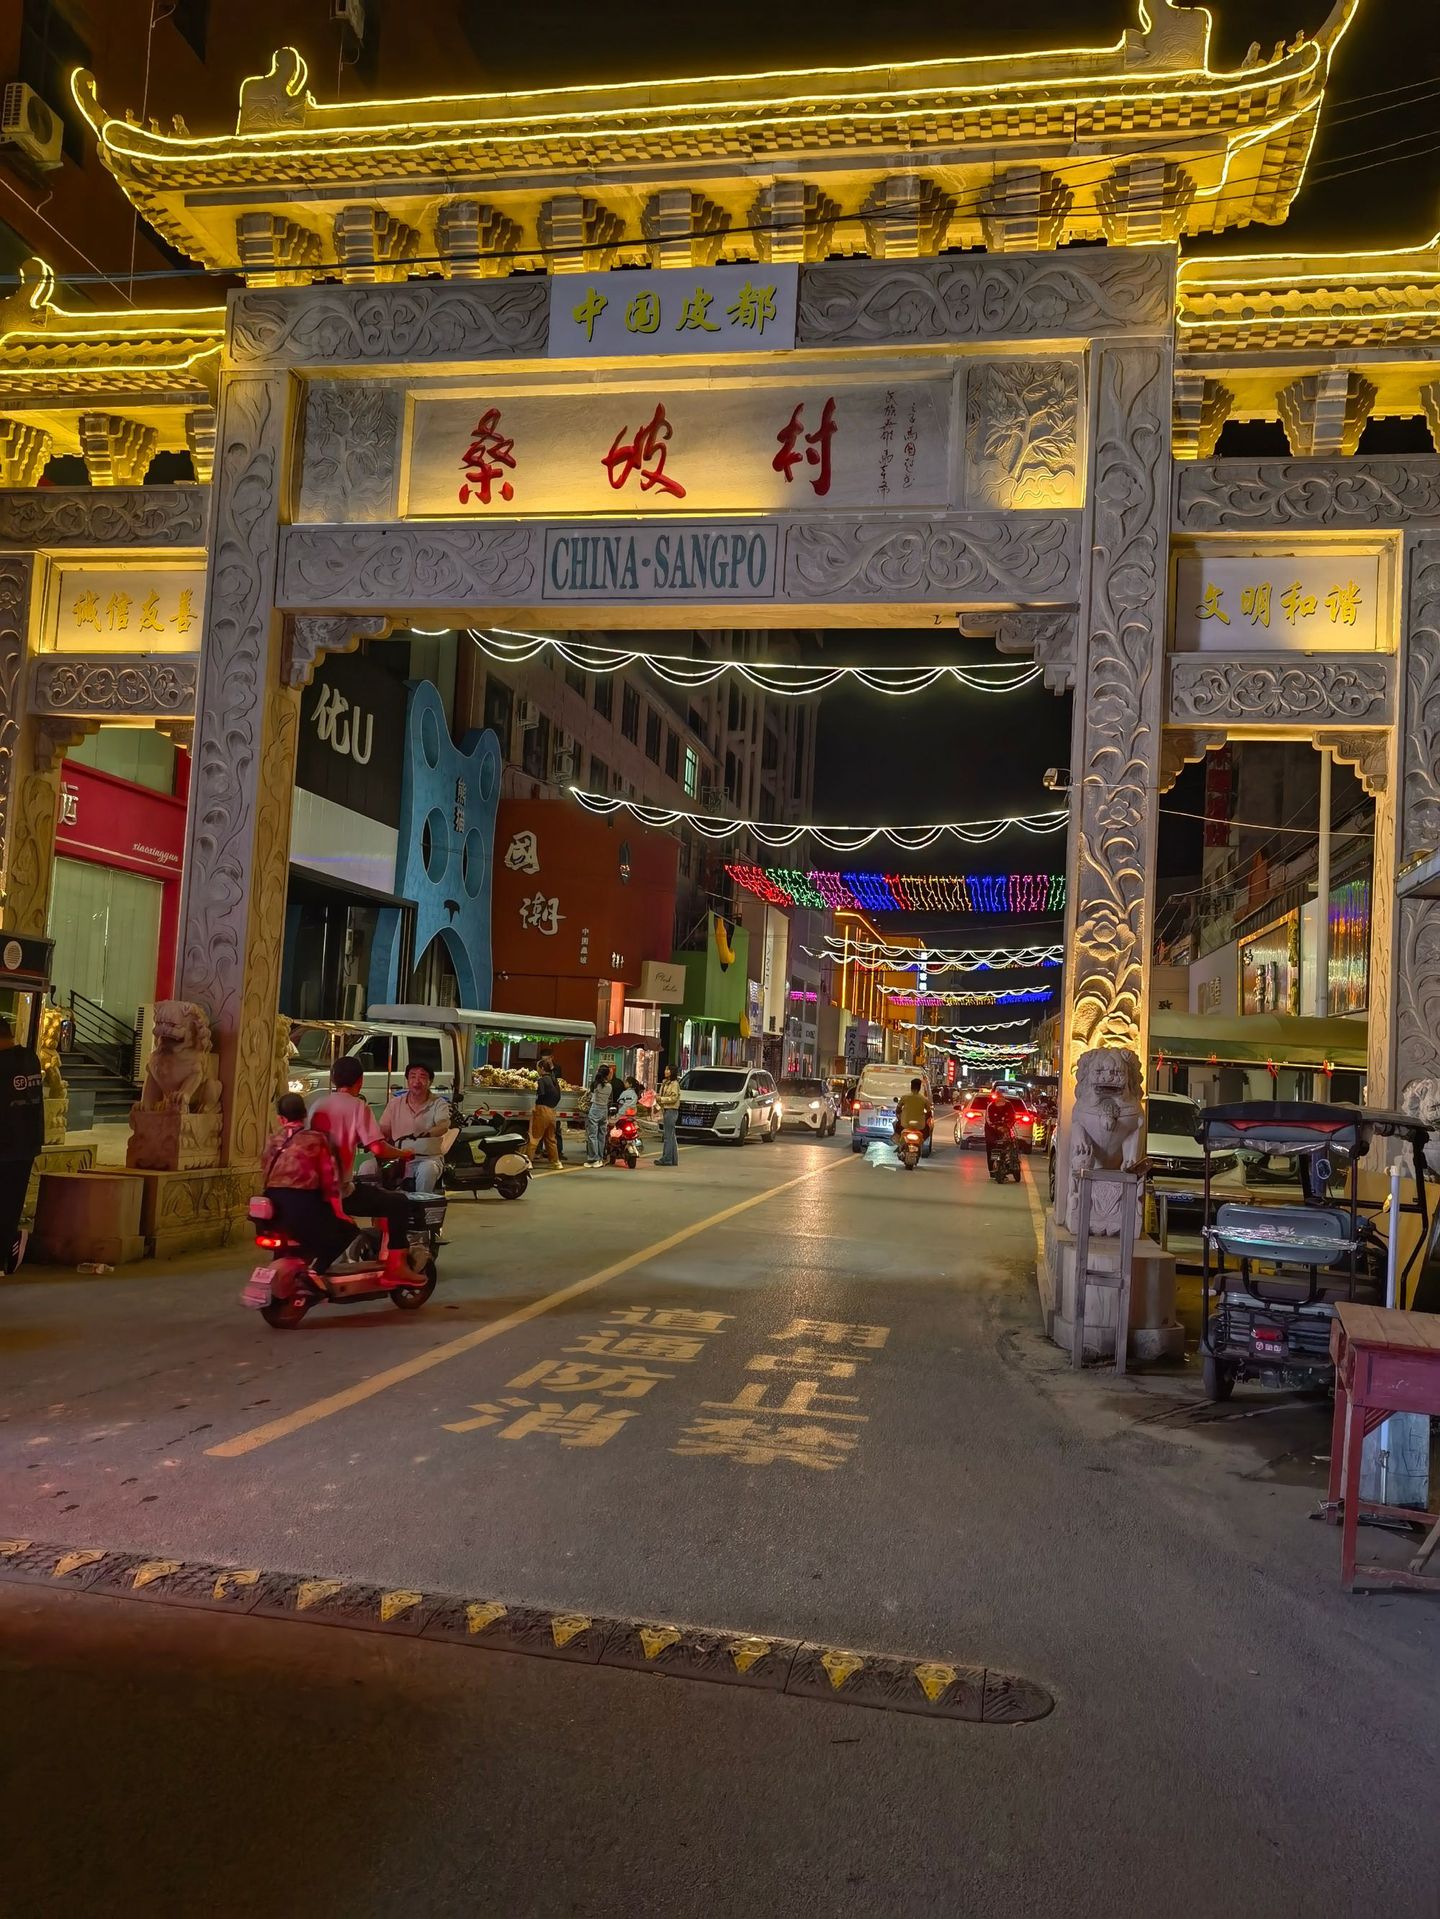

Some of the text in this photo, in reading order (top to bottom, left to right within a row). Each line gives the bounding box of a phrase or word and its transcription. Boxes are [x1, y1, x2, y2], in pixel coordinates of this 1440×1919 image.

[573, 280, 778, 343] 中国皮都
[458, 397, 838, 505] 桑坡村
[72, 588, 199, 634] 诚信友善
[1195, 580, 1363, 627] 文明和谐
